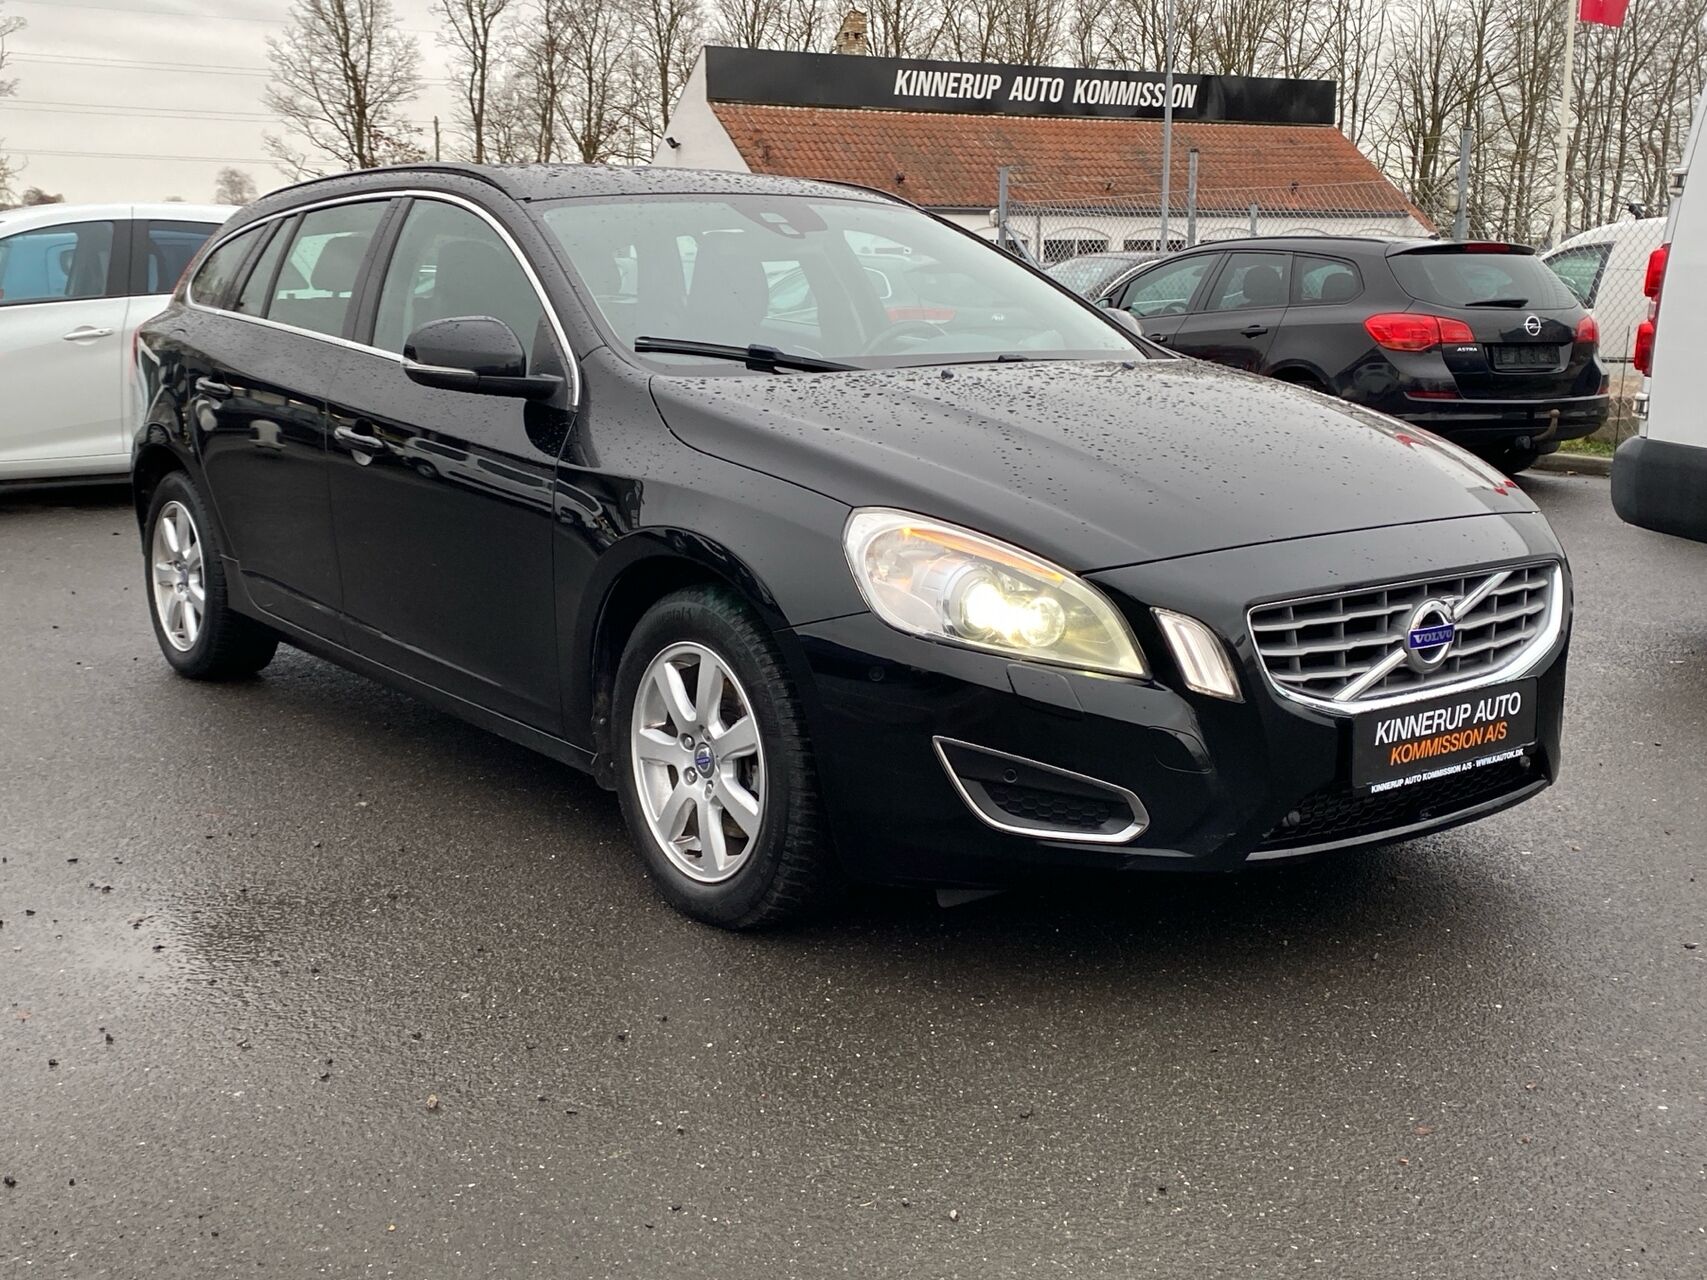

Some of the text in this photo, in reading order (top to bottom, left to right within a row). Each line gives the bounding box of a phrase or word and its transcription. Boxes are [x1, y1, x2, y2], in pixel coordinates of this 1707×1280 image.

[894, 69, 1198, 109] KINNERUP AUTO KOMMISSON
[1413, 629, 1453, 644] VOLVO
[1375, 691, 1521, 745] KINNERUP AUTO
[1390, 721, 1508, 766] KOMMISSION A/S
[1371, 778, 1404, 794] KINNERUP
[1404, 774, 1422, 786] AUTO
[1422, 764, 1461, 781] KOMMISSION
[1462, 761, 1473, 771] A/S
